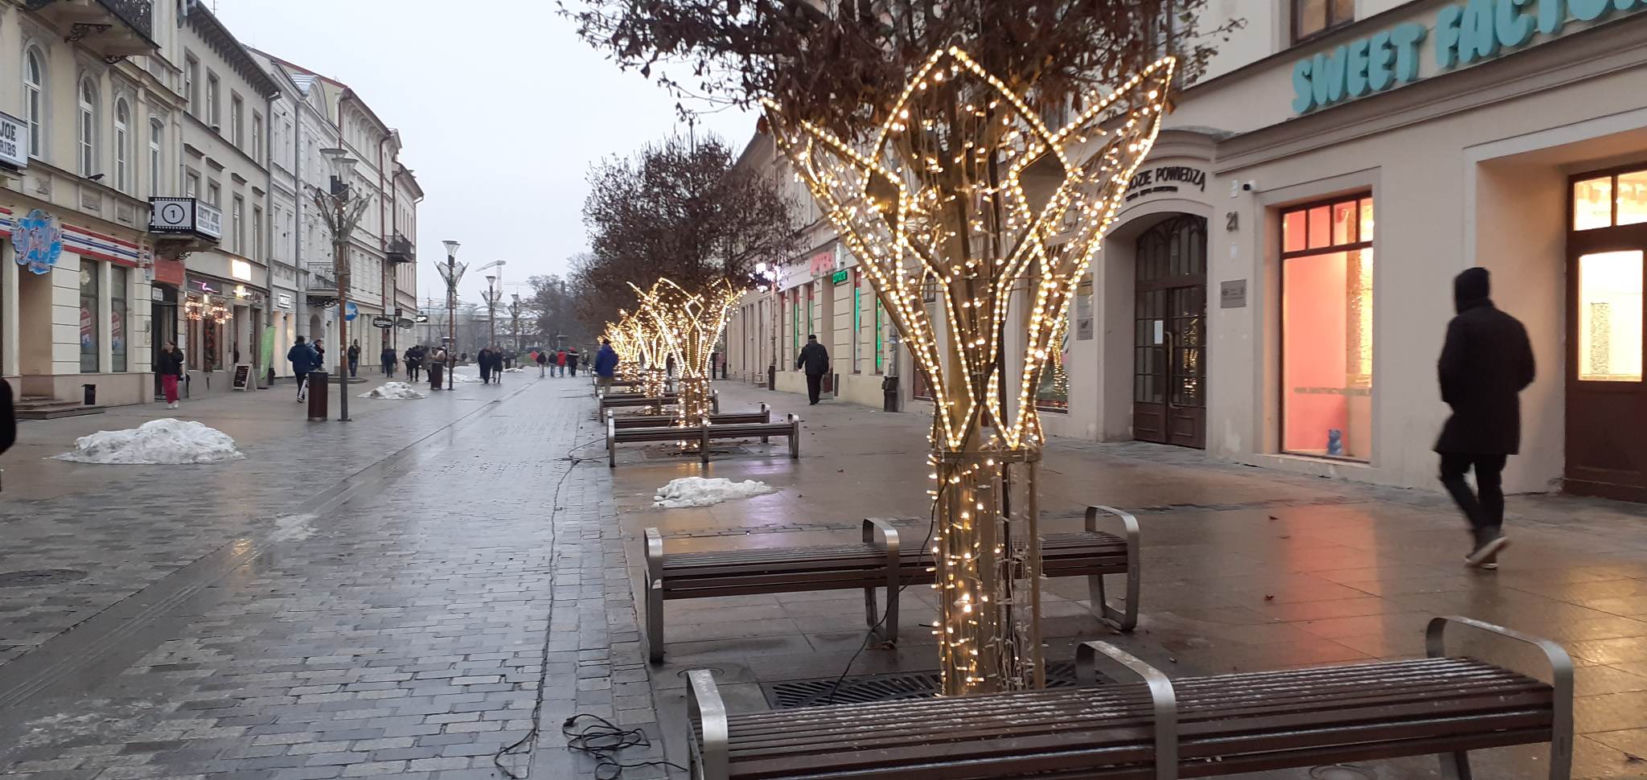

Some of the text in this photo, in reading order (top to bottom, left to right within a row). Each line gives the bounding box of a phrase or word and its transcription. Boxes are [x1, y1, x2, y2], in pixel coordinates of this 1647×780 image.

[1292, 22, 1427, 115] SWEET
[0, 120, 16, 142] JOE
[1127, 169, 1153, 192] DZIE
[170, 209, 176, 219] 1
[1226, 211, 1239, 232] 21
